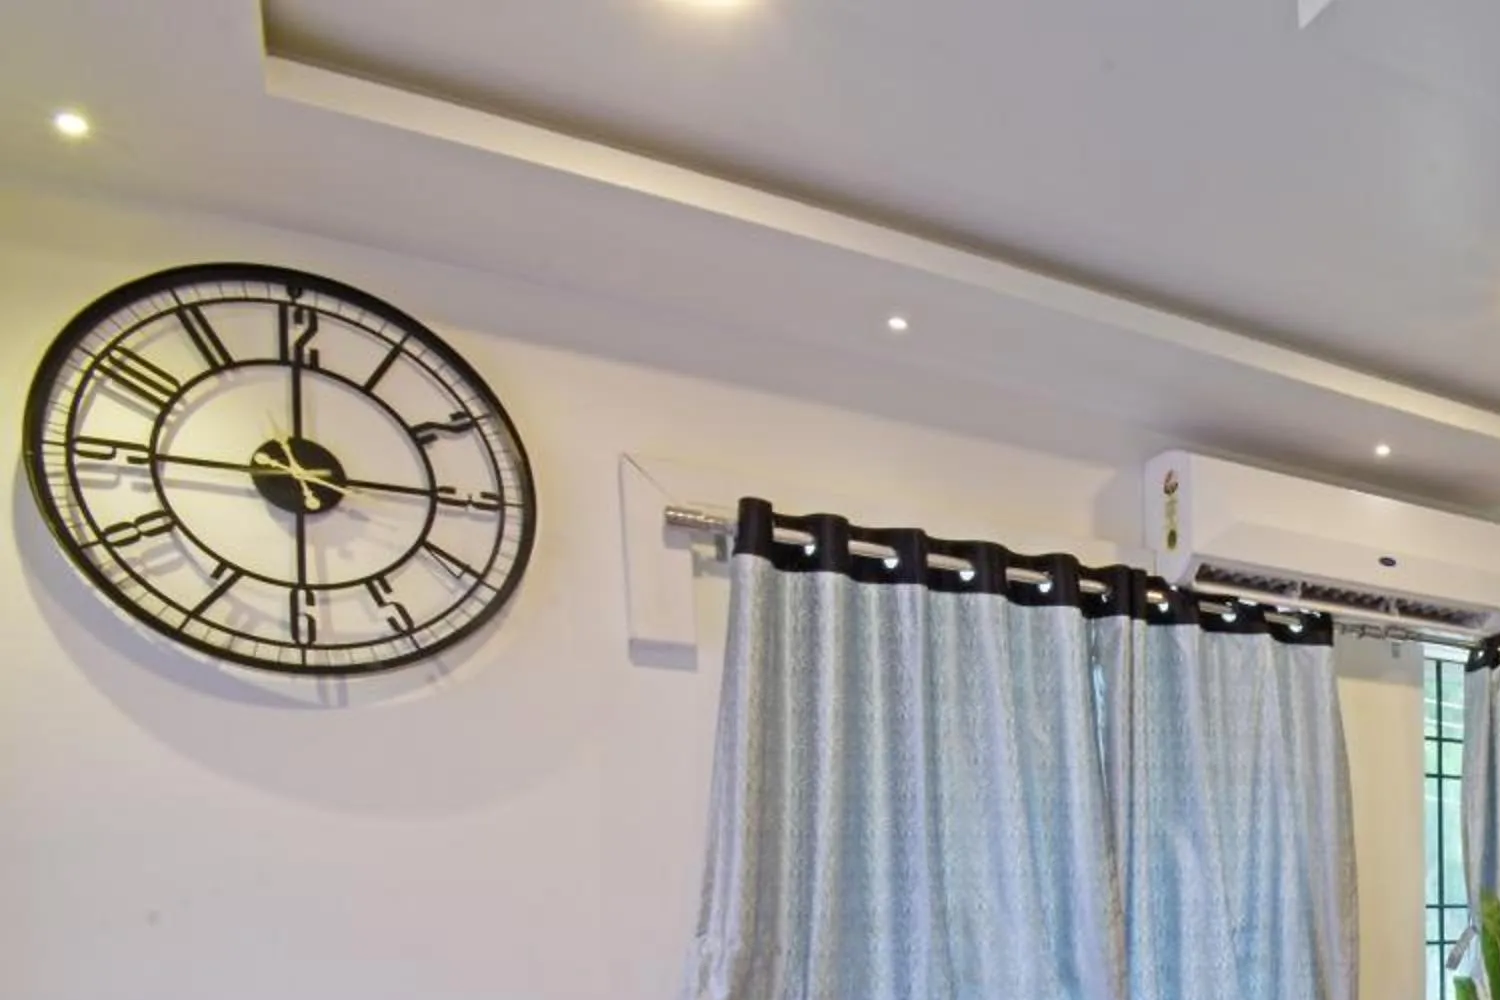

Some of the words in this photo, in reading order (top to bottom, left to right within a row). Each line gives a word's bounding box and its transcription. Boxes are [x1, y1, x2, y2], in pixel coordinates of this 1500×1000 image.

[176, 305, 236, 370] 11
[278, 302, 320, 370] 12
[95, 343, 182, 410] 10
[363, 343, 404, 394] 1
[73, 436, 152, 465] 9
[409, 410, 476, 446] 2
[436, 485, 501, 512] 3
[102, 509, 177, 547] 8
[423, 540, 483, 580] 4
[189, 561, 242, 617] 7
[366, 575, 415, 633] 5
[289, 588, 317, 647] 6
